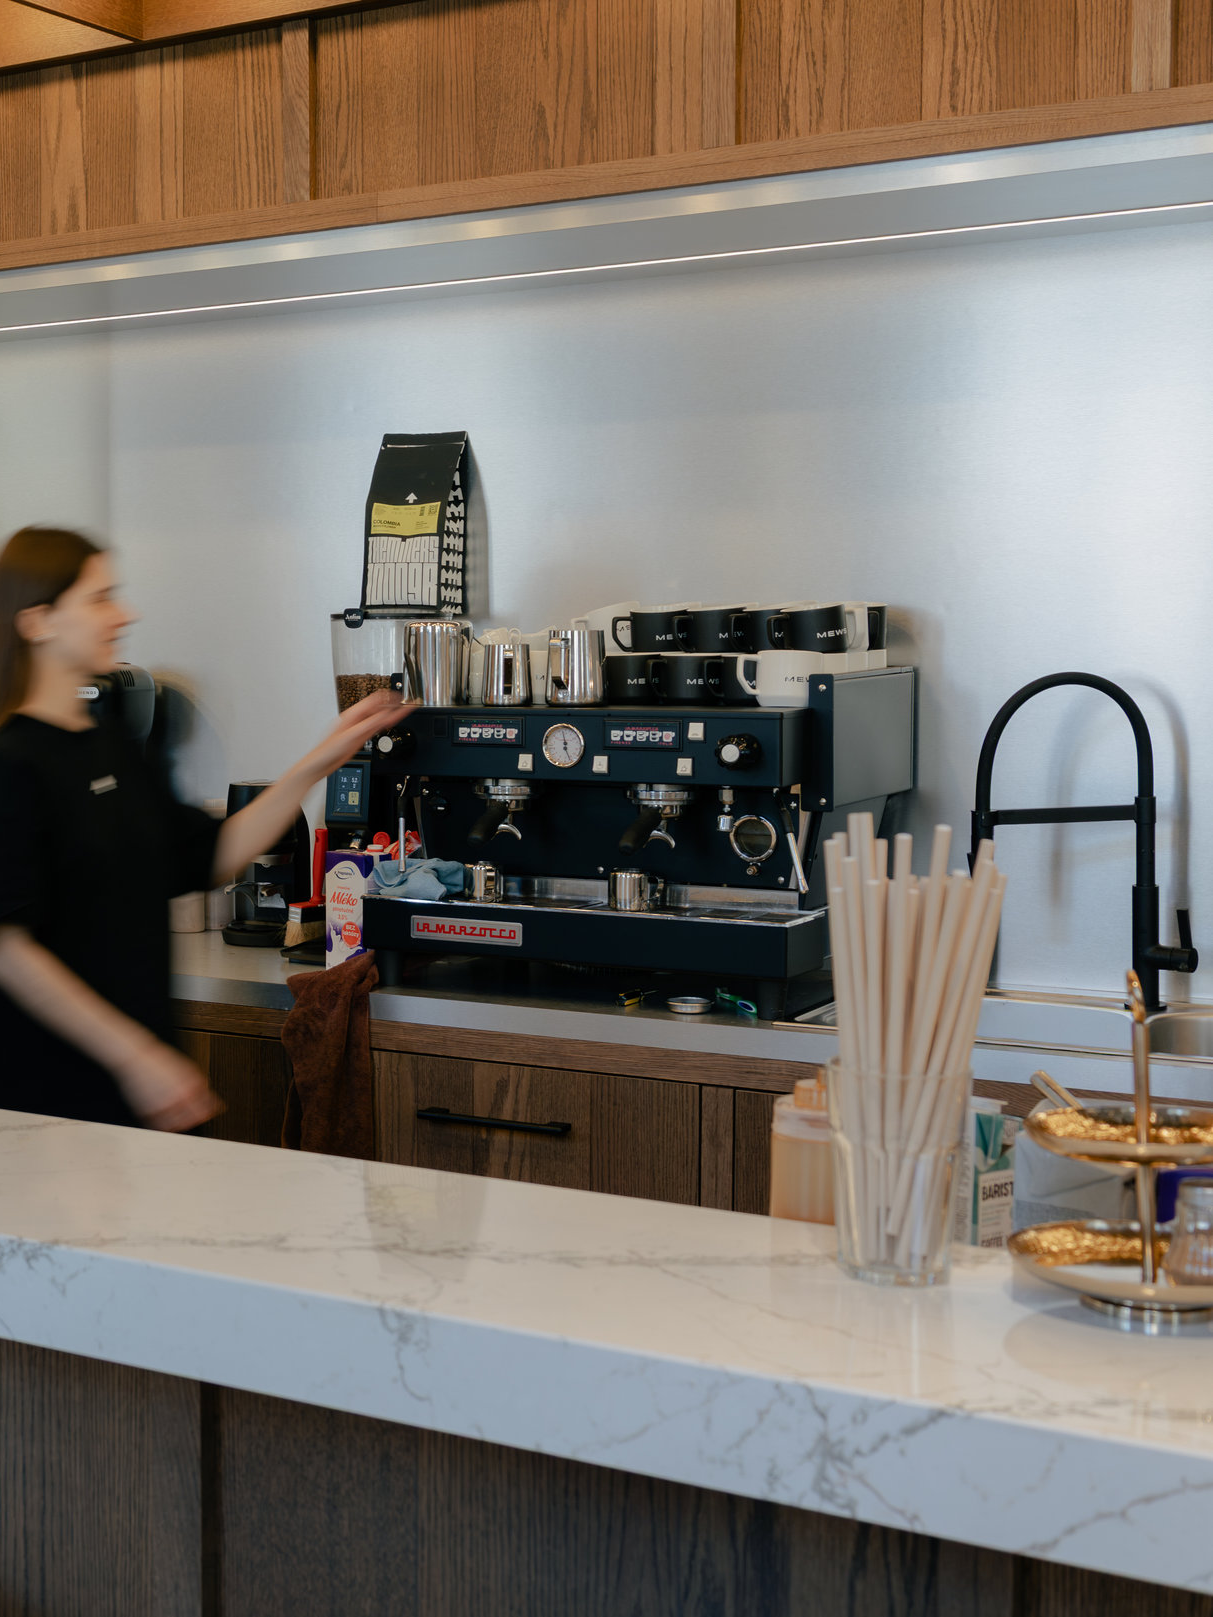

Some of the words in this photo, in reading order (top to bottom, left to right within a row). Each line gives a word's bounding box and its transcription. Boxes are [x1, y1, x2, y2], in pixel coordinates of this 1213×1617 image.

[373, 519, 401, 527] COLOMBIA
[816, 627, 847, 639] MEWS
[329, 891, 358, 907] Mléko
[982, 1181, 1014, 1200] BARIST
